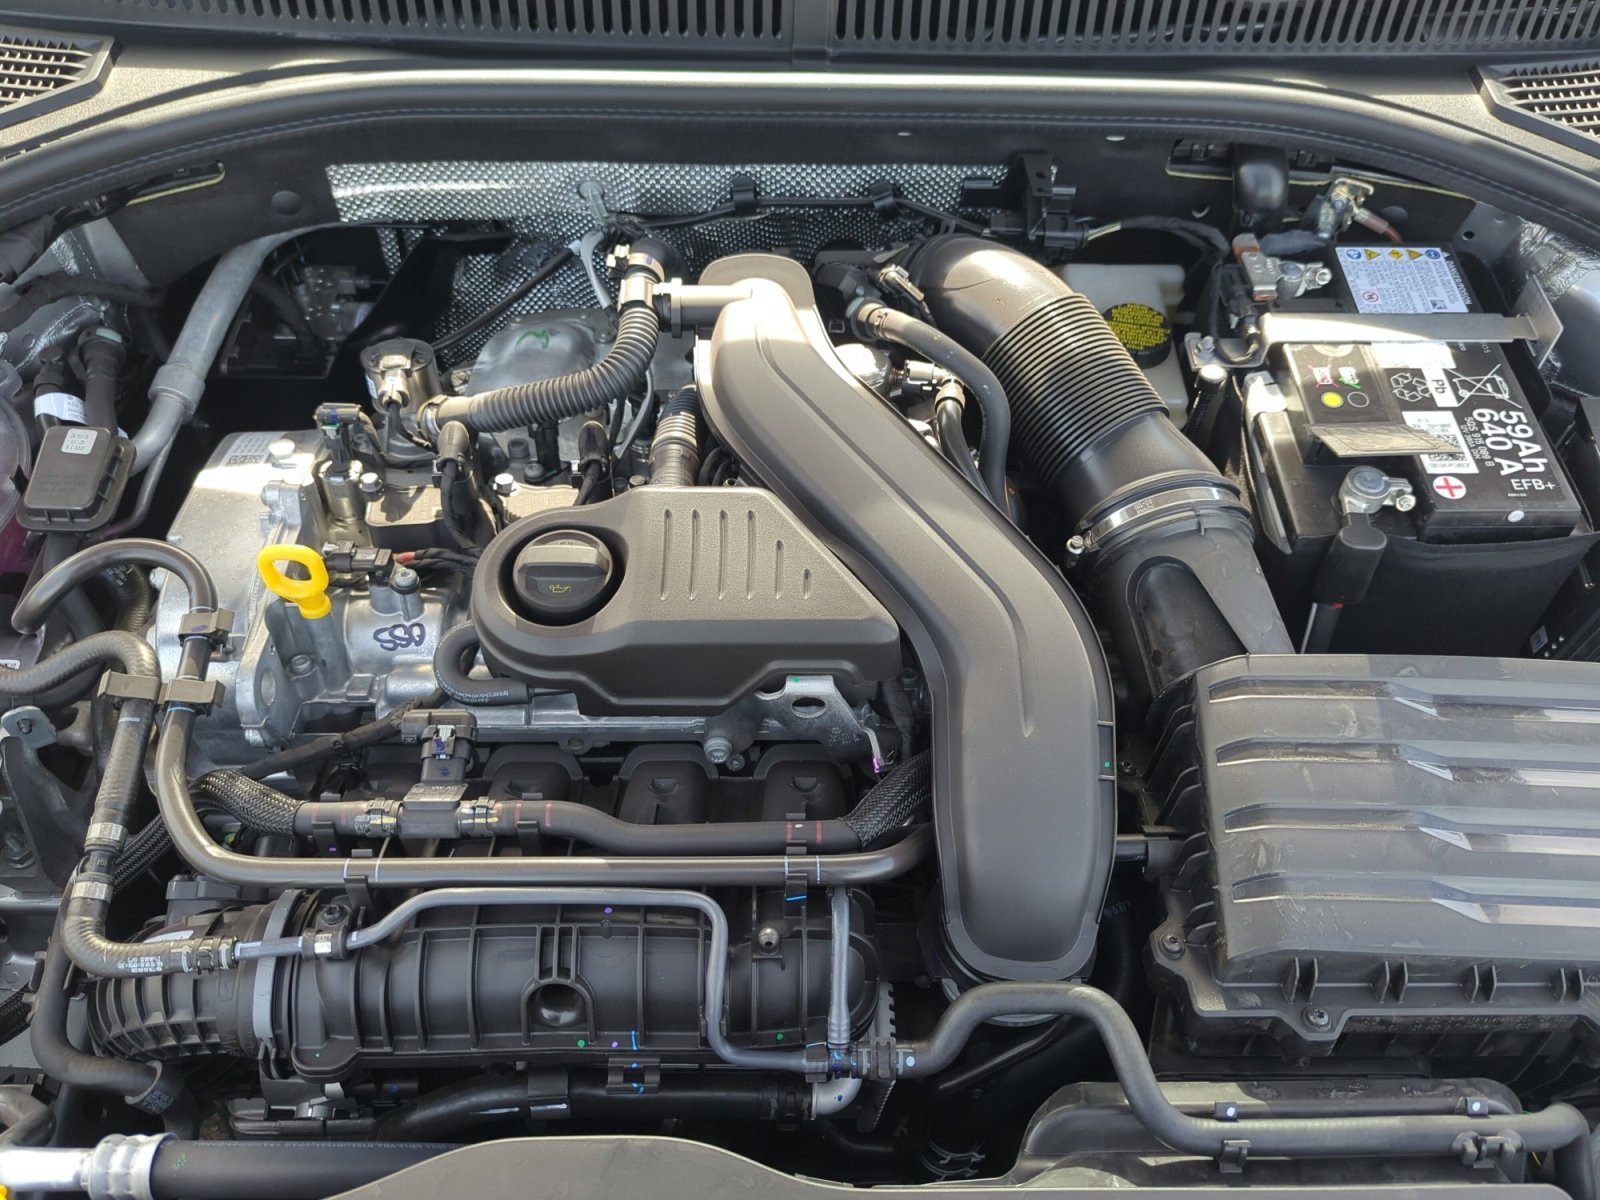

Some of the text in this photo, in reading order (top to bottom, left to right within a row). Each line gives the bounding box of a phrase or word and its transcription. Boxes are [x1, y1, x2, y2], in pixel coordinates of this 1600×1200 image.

[1431, 379, 1447, 394] Pb
[1471, 432, 1485, 445] 915
[1472, 408, 1513, 451] 640
[1493, 457, 1524, 476] A
[1499, 410, 1548, 472] 59Ah
[1510, 478, 1556, 490] EFB+
